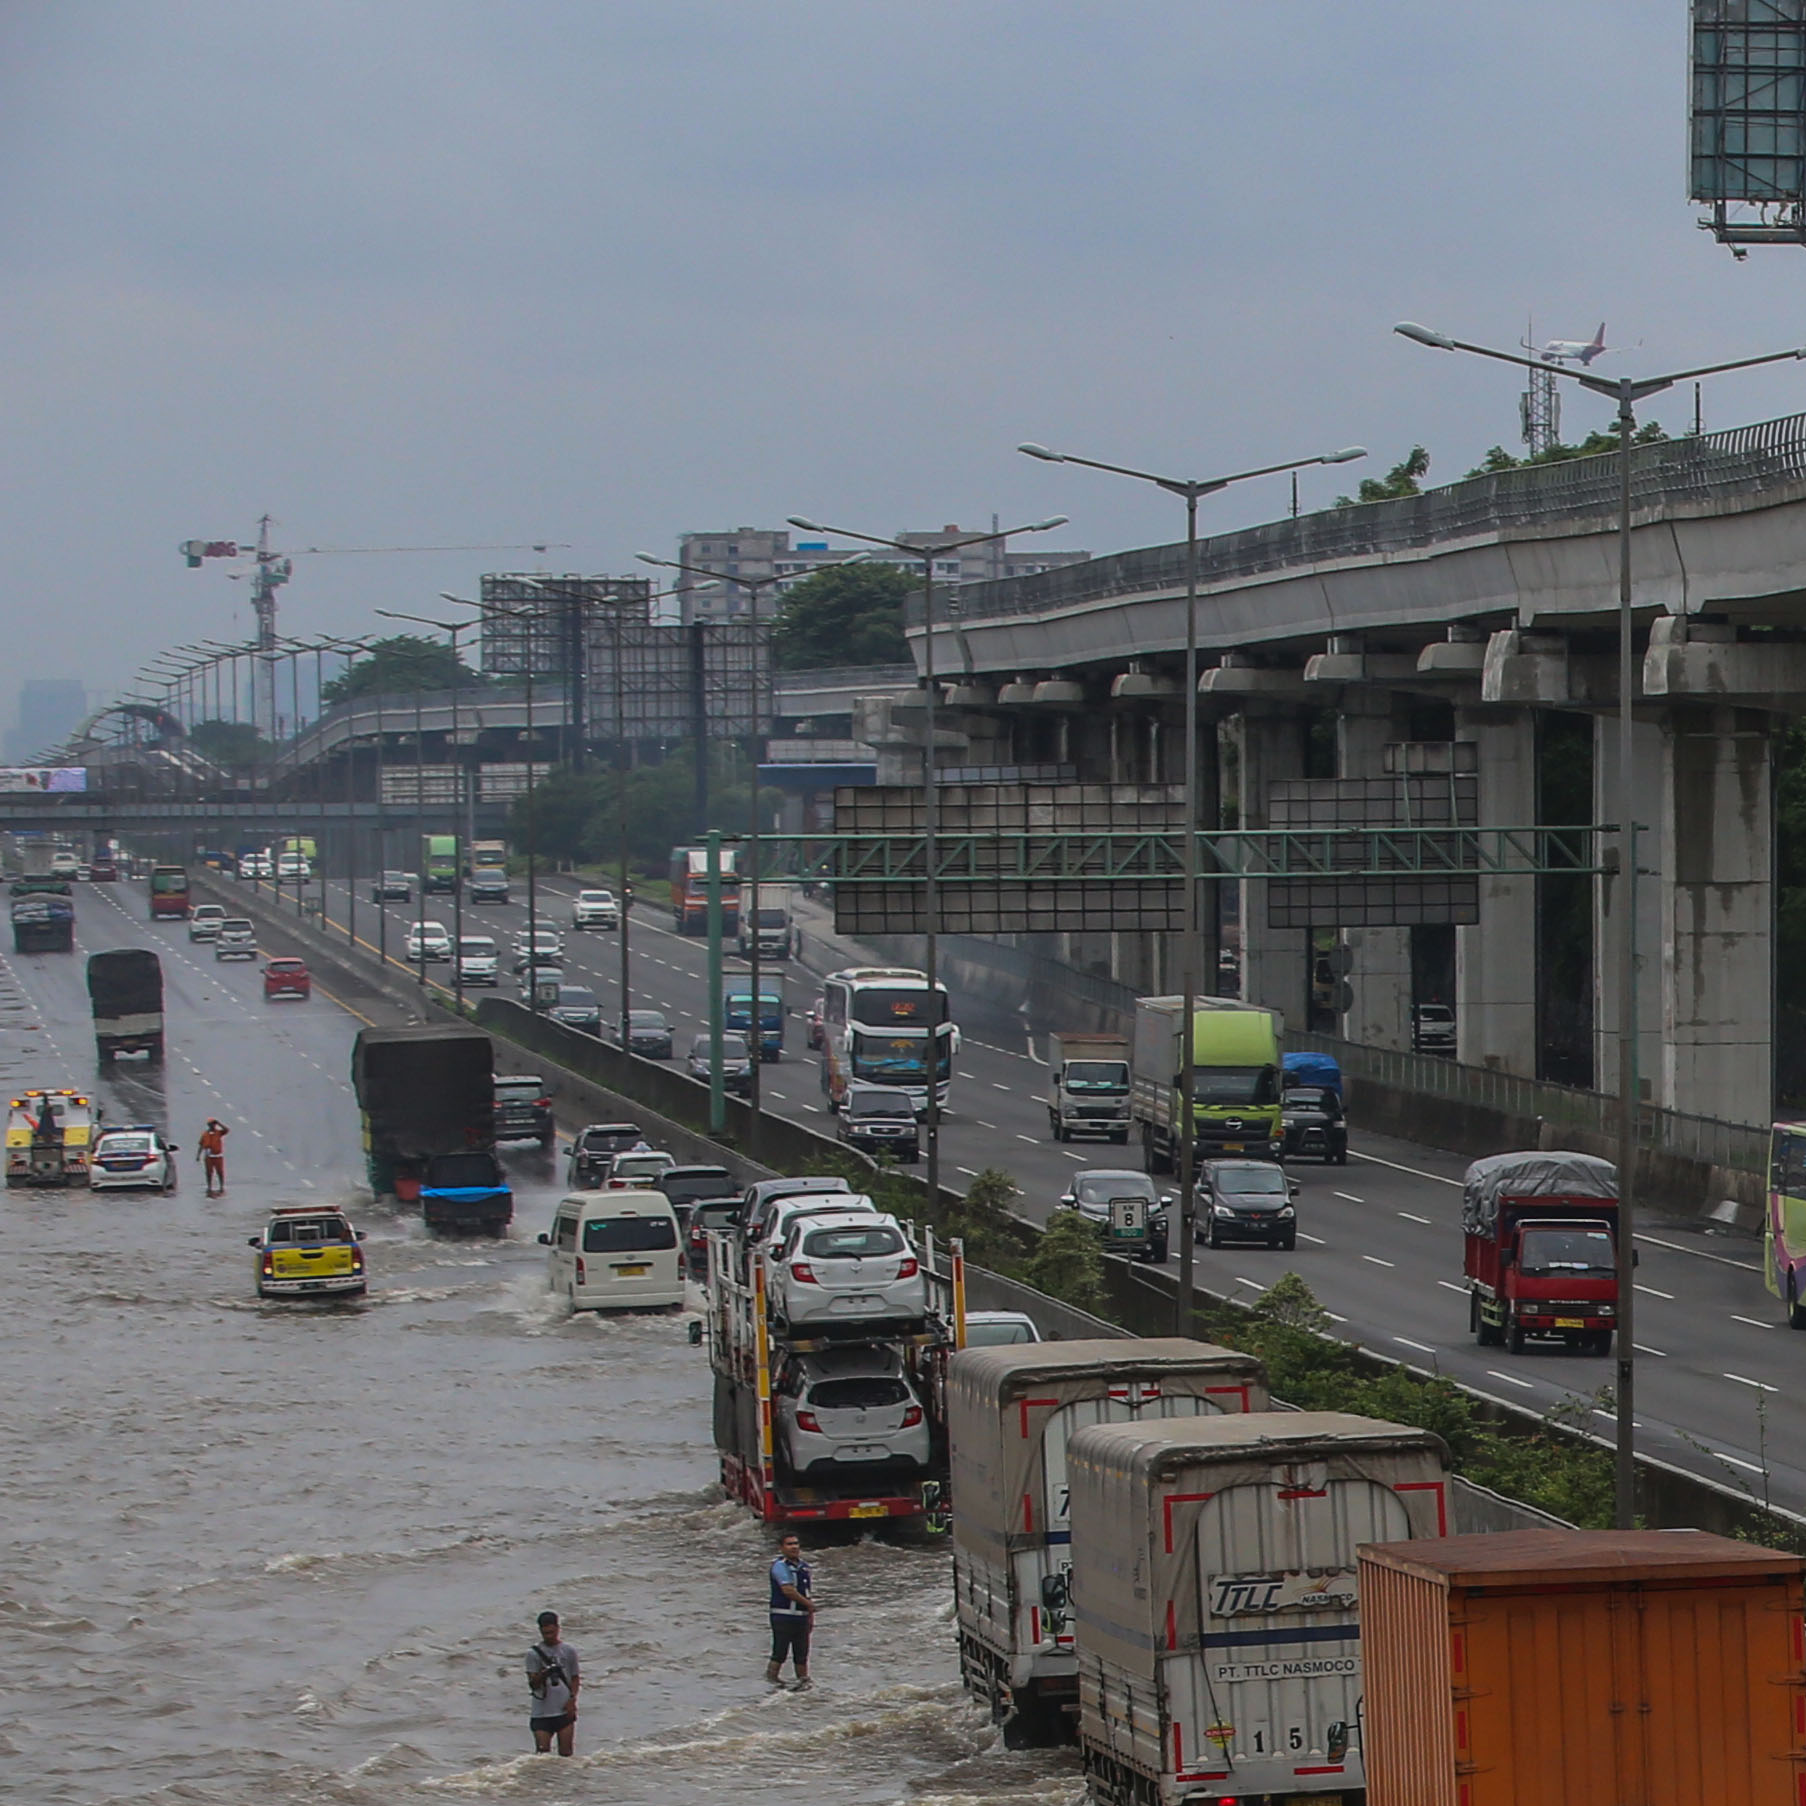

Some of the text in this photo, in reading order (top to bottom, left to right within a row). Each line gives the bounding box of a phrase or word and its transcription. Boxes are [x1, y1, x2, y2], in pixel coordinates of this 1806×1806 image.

[1124, 1212, 1134, 1227] 8
[1215, 1579, 1284, 1613] TTLC
[1218, 1659, 1356, 1679] PT. TTLC NASMOCO
[1253, 1730, 1265, 1753] 1
[1289, 1727, 1302, 1750] 5
